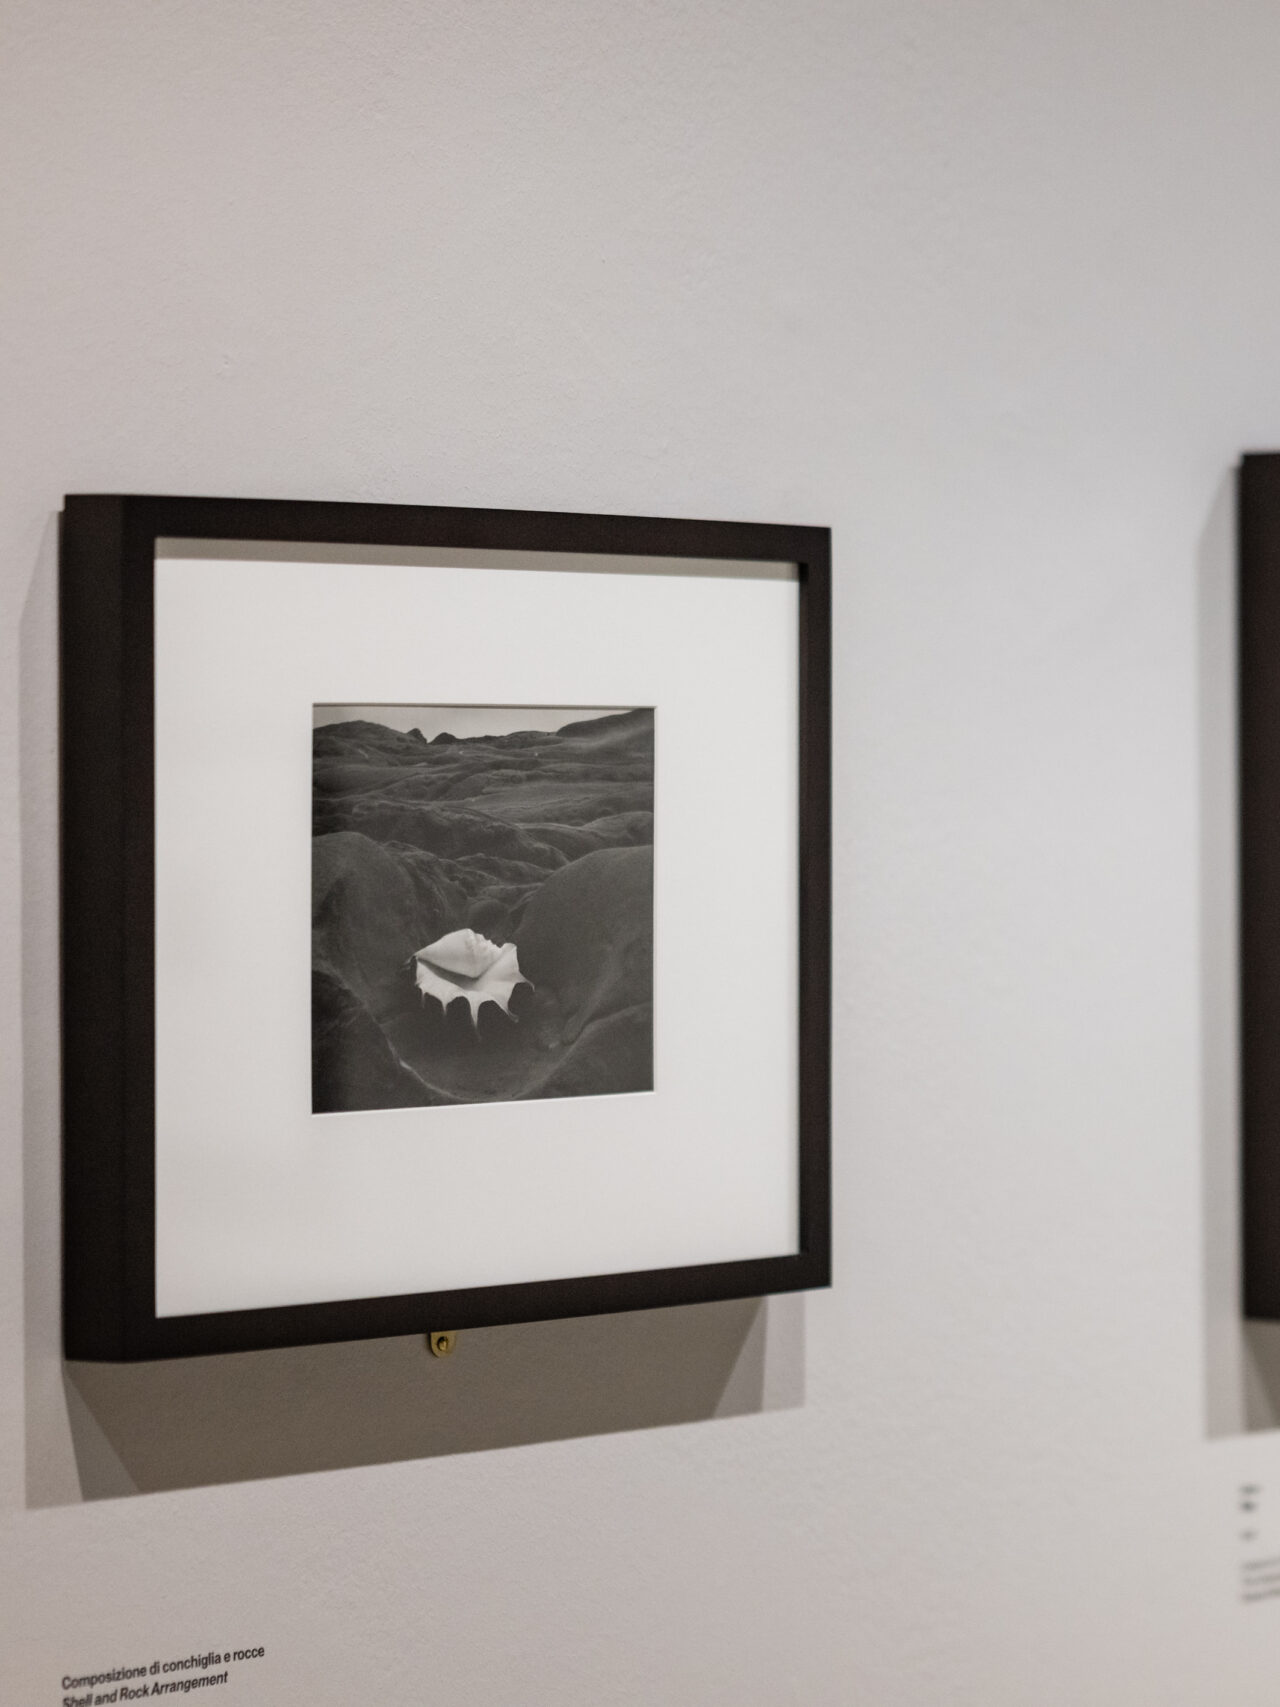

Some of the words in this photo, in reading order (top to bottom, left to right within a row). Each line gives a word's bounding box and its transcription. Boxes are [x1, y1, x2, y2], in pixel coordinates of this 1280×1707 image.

[61, 1666, 147, 1690] Composizione
[149, 1661, 161, 1676] di
[162, 1651, 221, 1670] conchiglia
[223, 1652, 231, 1663] e
[233, 1646, 265, 1661] rocce
[62, 1693, 93, 1707] Shell
[94, 1688, 118, 1706] and
[120, 1684, 149, 1701] Rock
[150, 1670, 229, 1696] Arrangement
